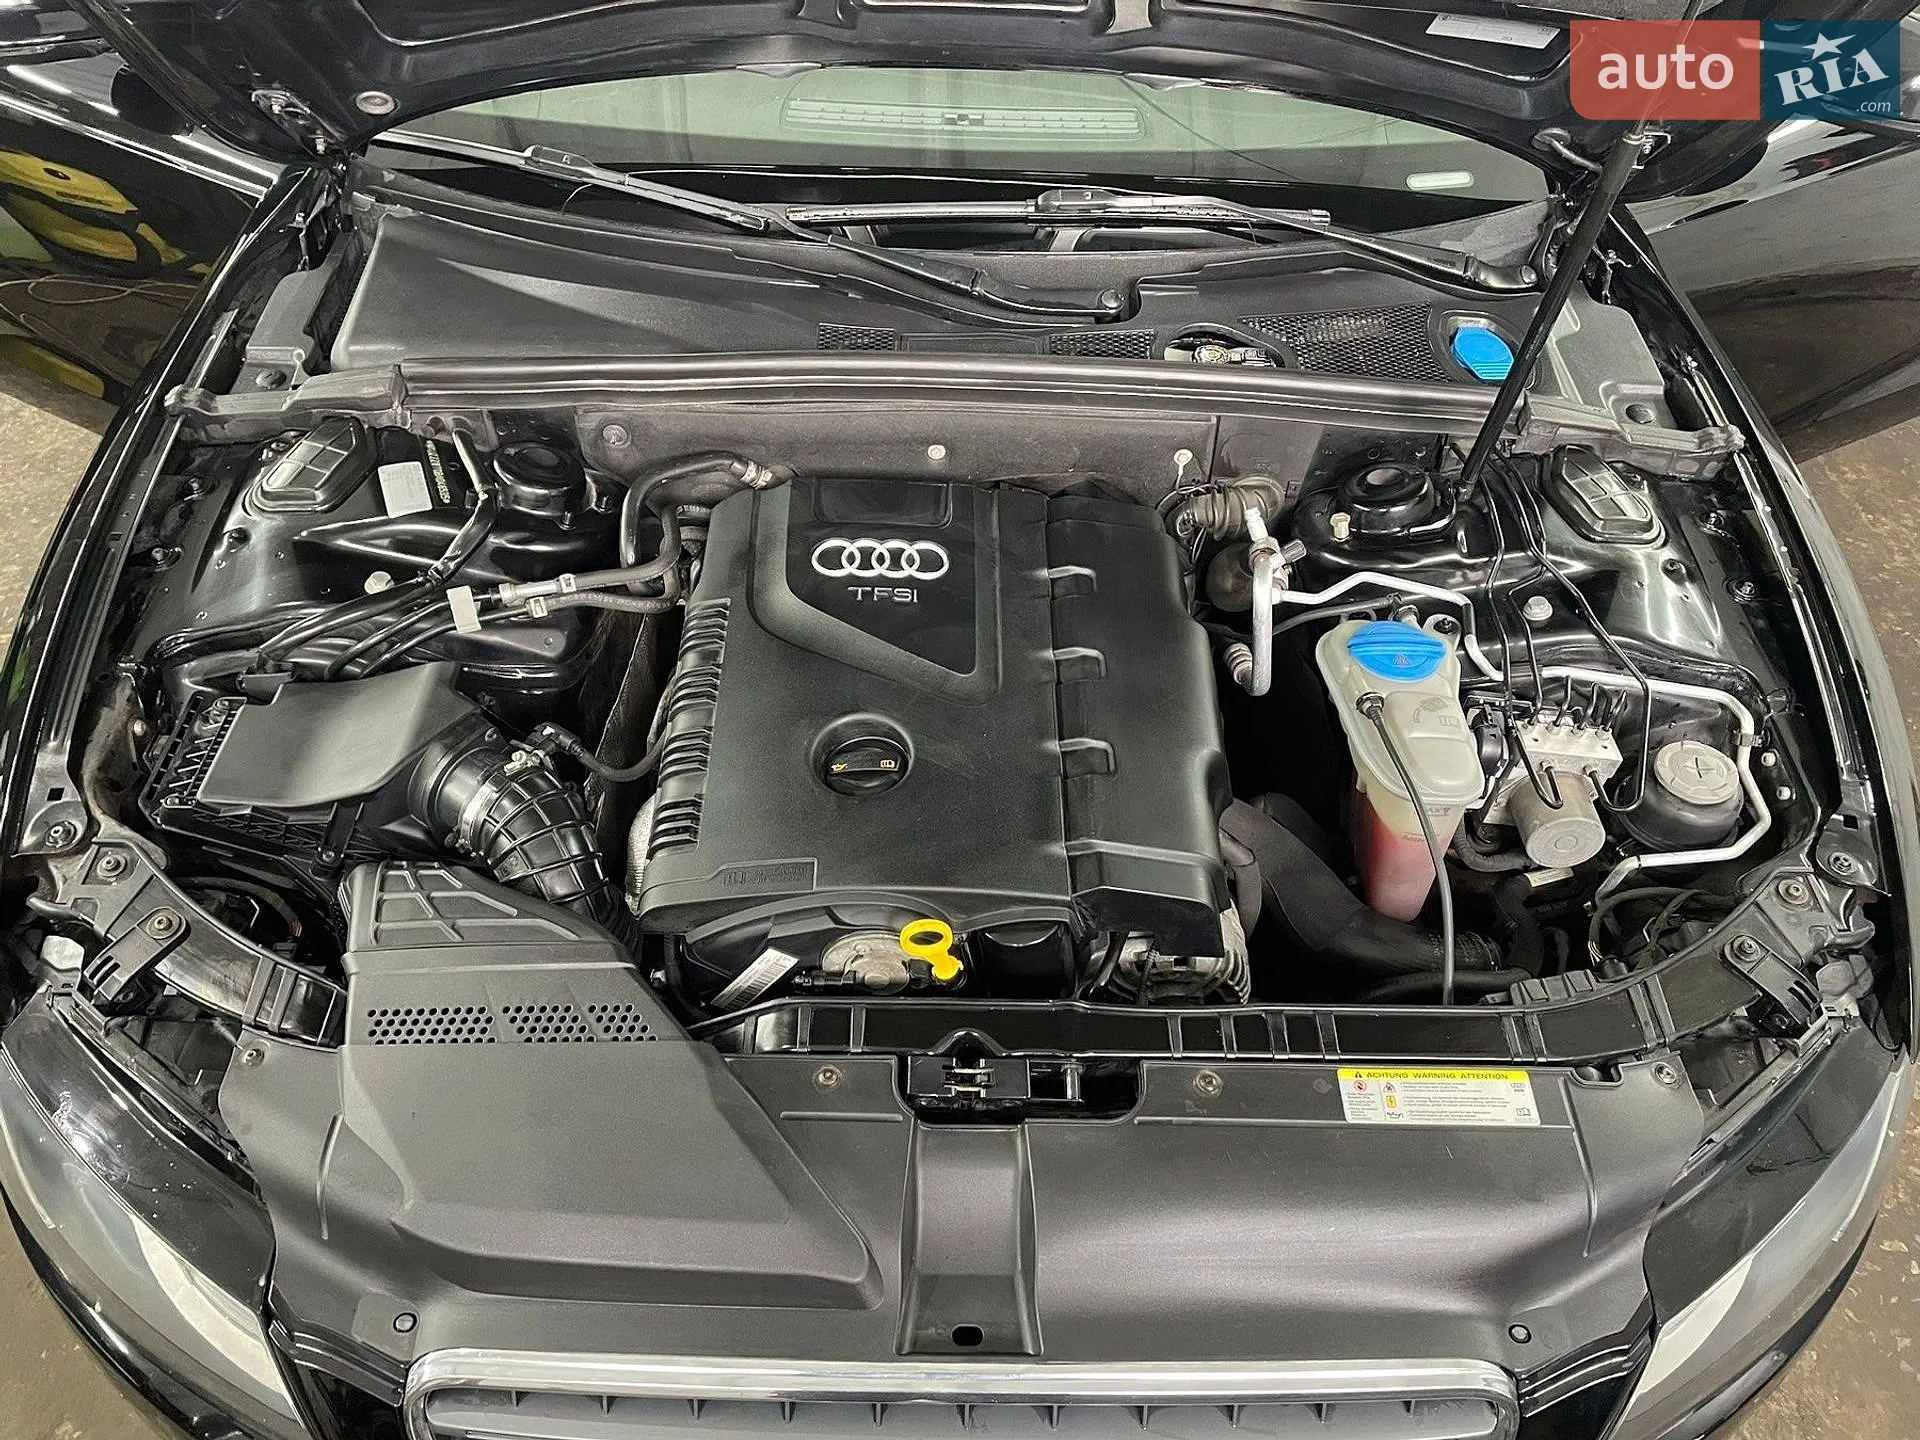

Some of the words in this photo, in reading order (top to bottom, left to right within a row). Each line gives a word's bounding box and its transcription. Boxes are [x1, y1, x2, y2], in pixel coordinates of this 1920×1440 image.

[847, 586, 919, 603] TFSI
[1366, 1071, 1409, 1079] ACHTUNG
[1460, 1072, 1509, 1080] ATTENTION
